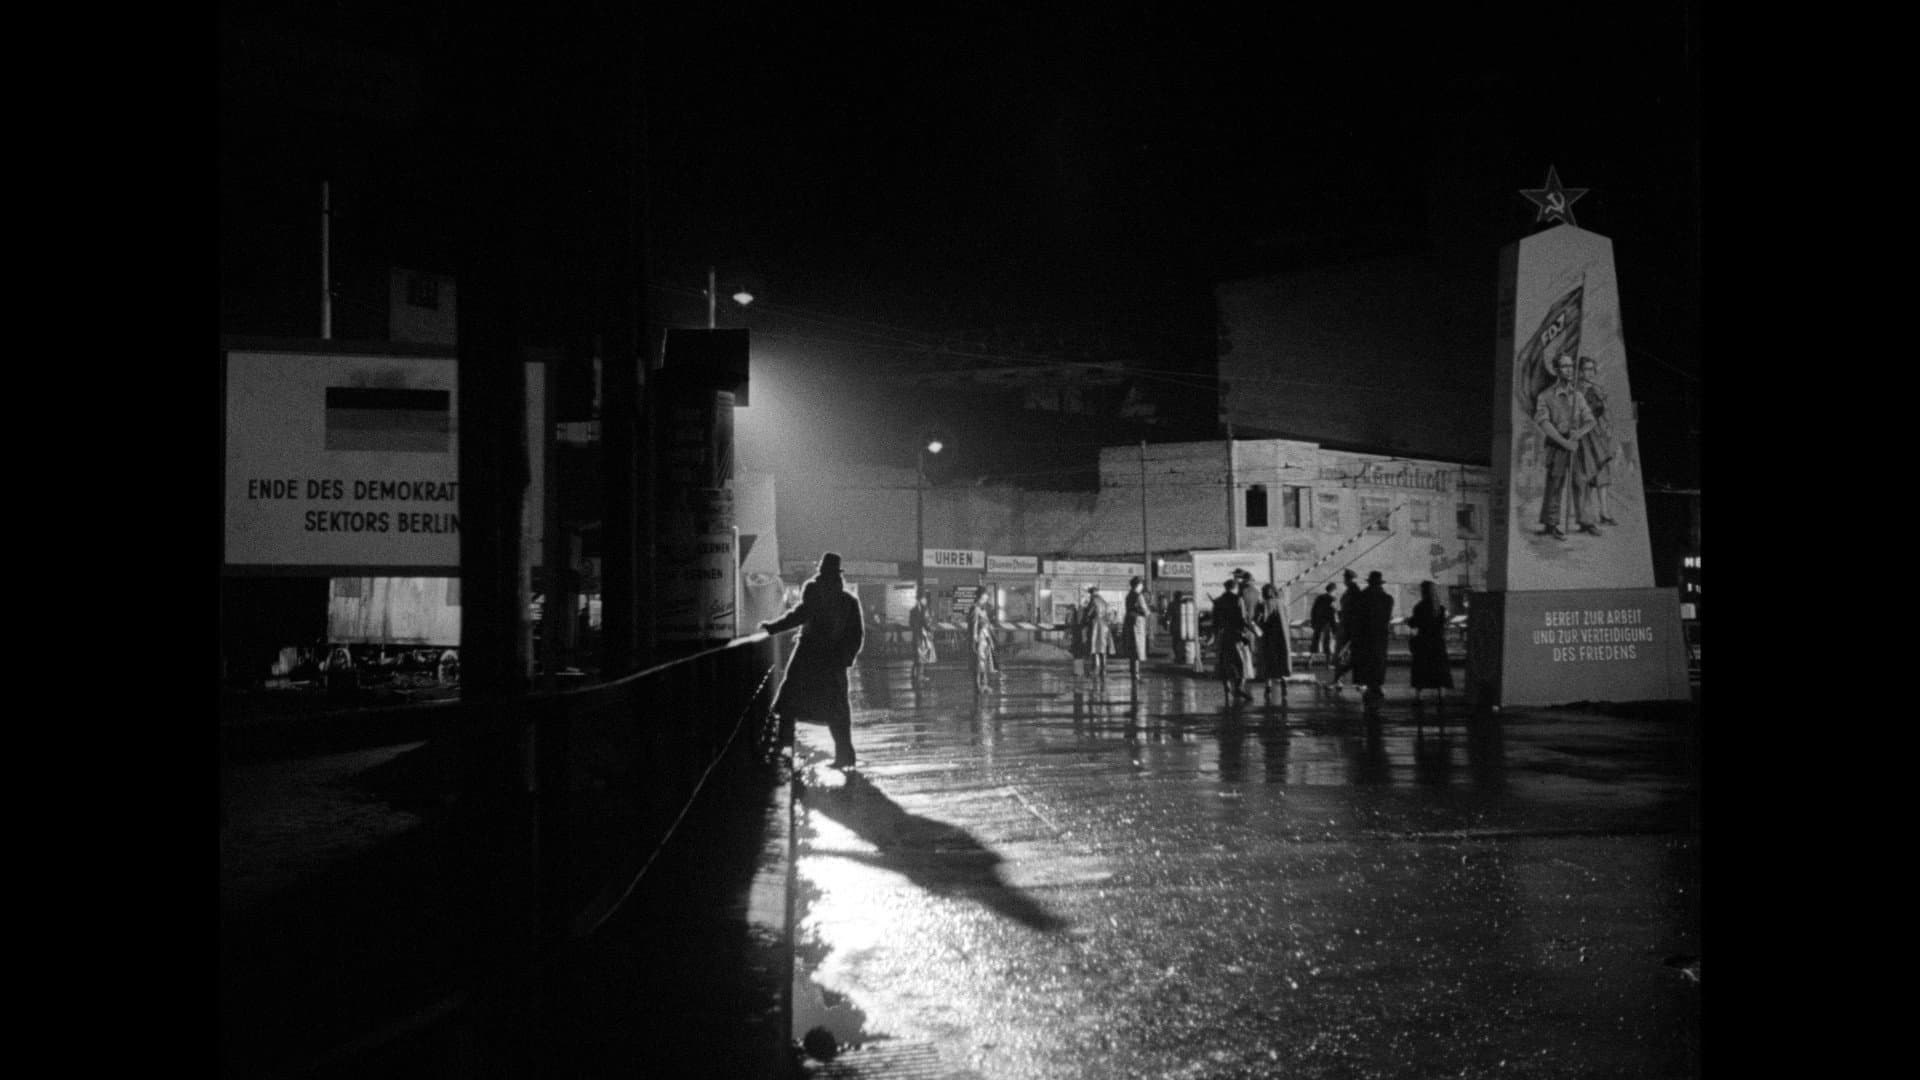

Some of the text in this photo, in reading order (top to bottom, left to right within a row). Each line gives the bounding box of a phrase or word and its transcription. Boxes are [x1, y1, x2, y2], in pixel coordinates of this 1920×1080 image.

[1541, 312, 1565, 346] FDJ
[248, 479, 298, 500] ENDE
[306, 479, 344, 500] DES
[304, 510, 462, 534] SEKTORS BERLIN
[935, 551, 973, 566] UHREN
[1545, 608, 1642, 627] BEREIT ZUR ARBEIT
[1533, 626, 1653, 645] UND ZUR VERTEIDIGUNG
[1553, 644, 1637, 662] DES FRIEDENS
